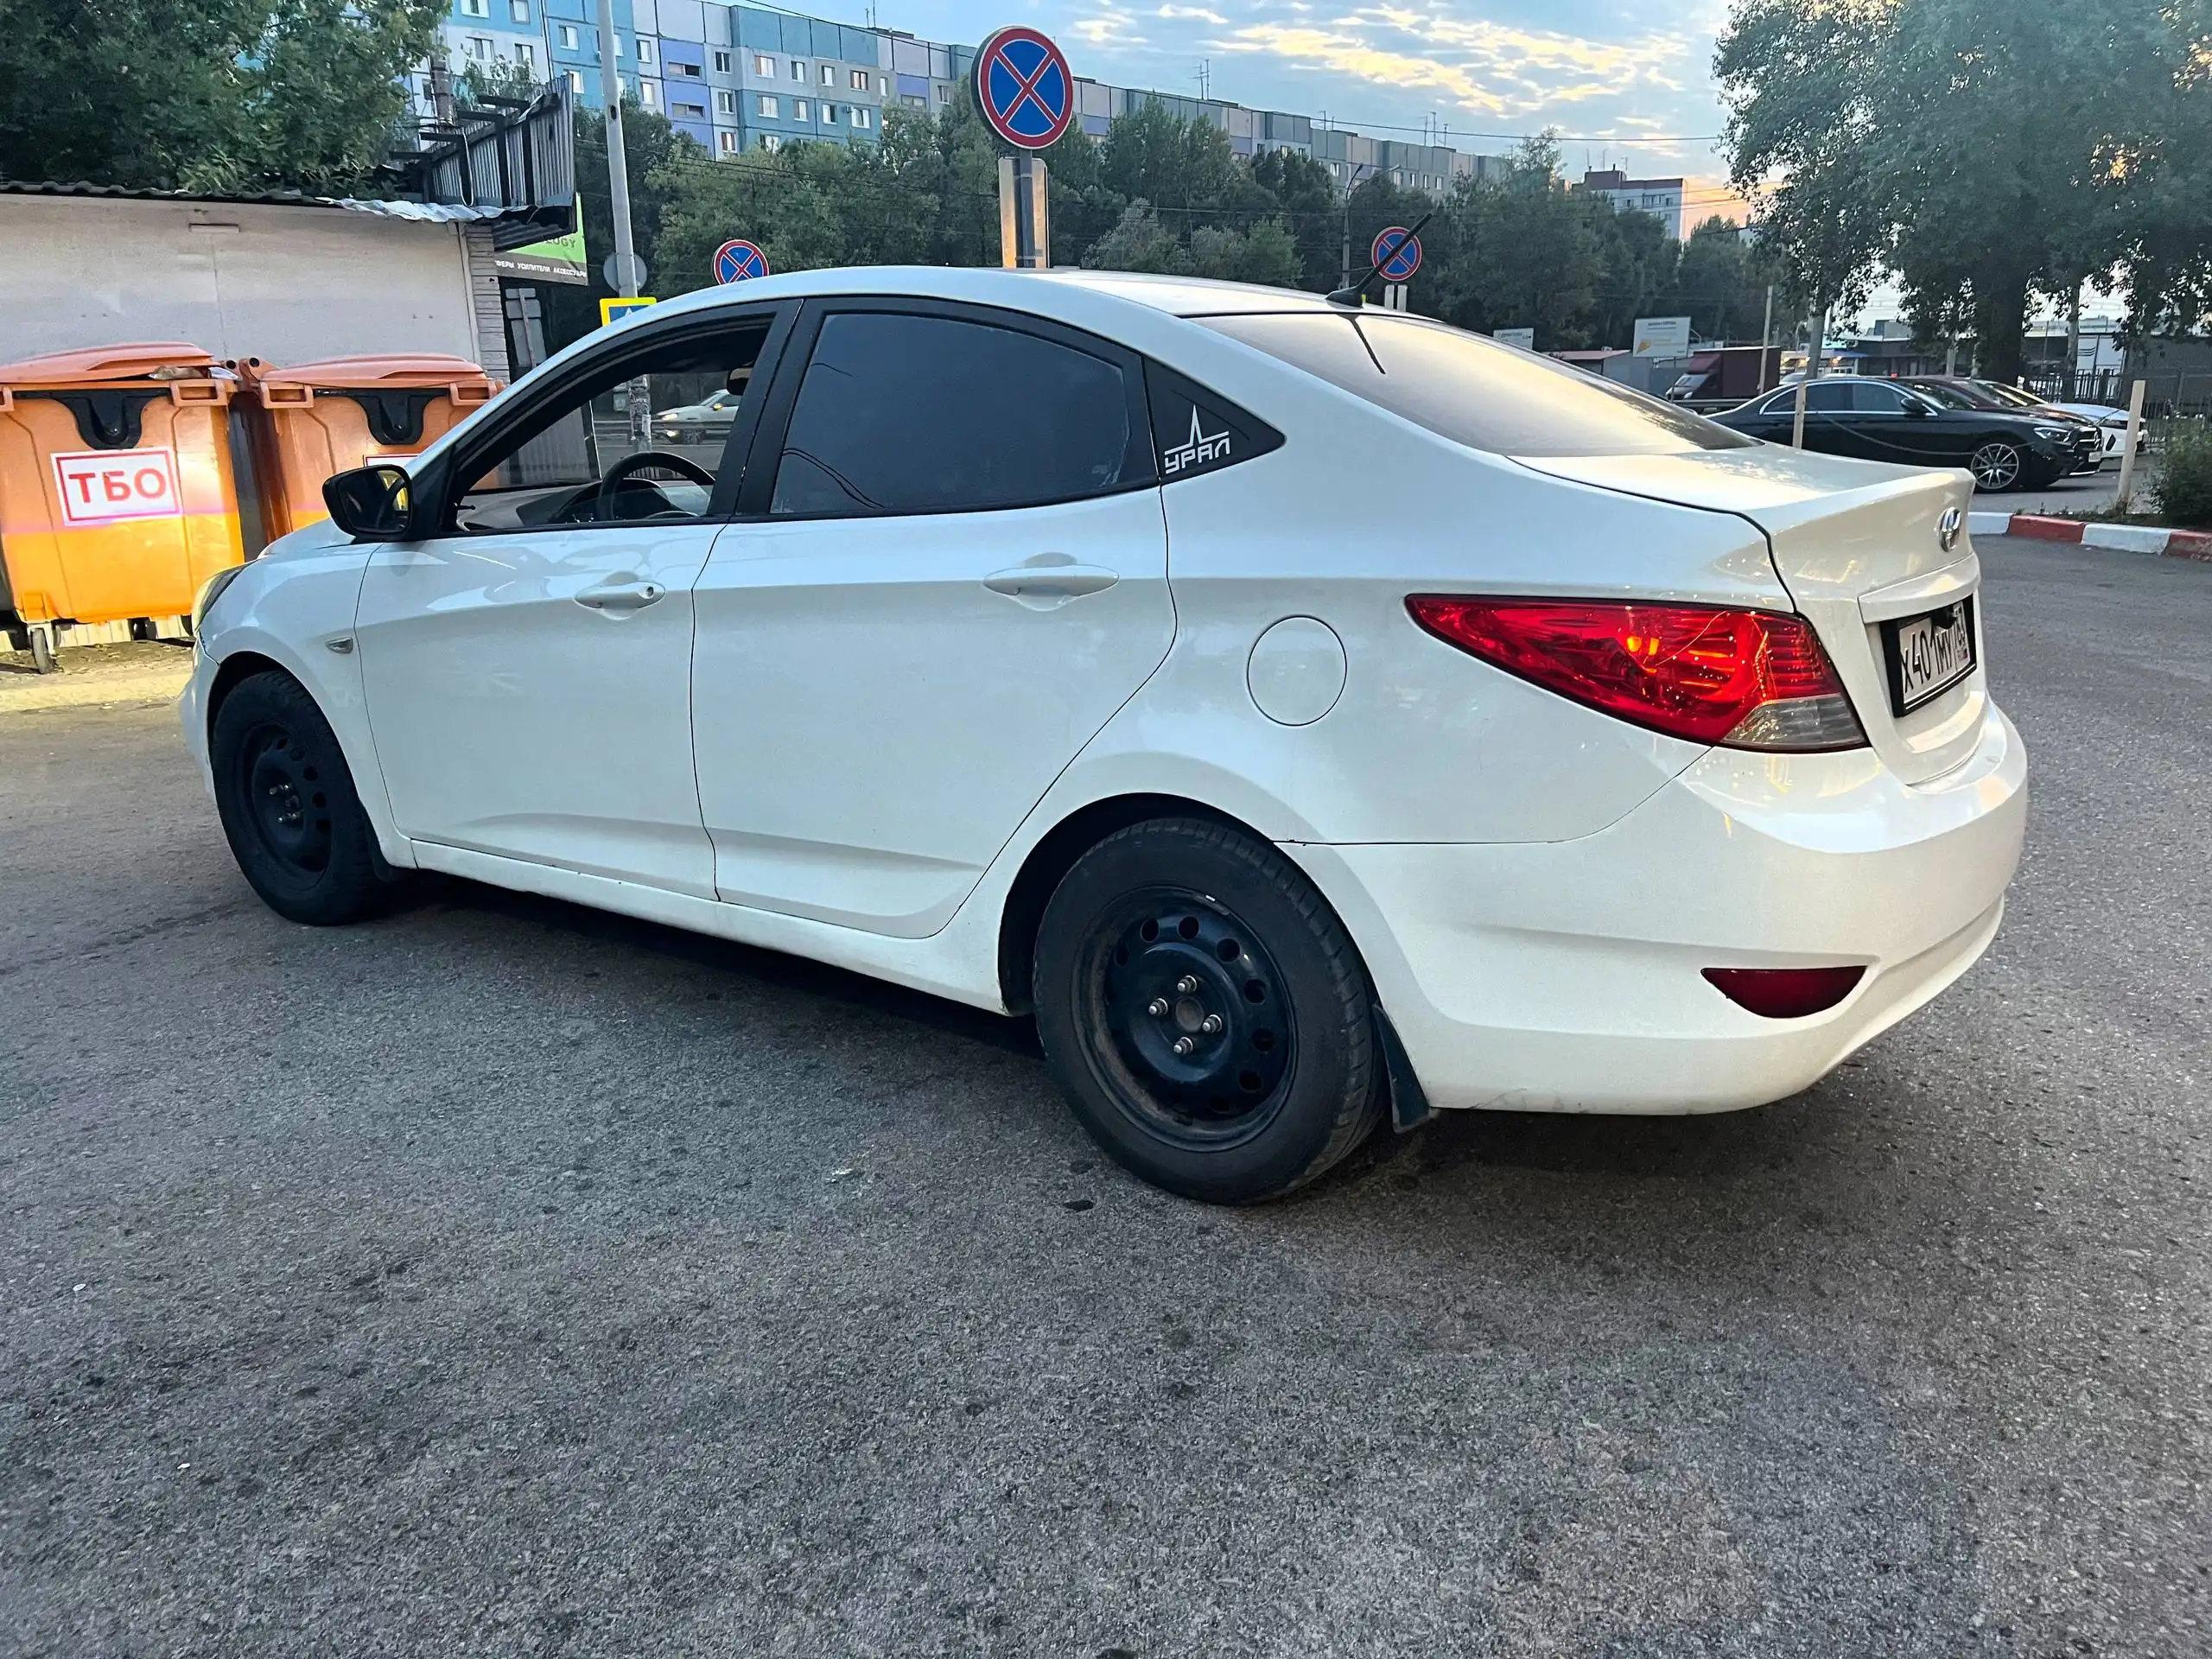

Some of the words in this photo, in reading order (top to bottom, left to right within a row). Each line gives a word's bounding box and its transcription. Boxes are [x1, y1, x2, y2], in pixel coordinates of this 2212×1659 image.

[517, 263, 550, 273] УСИЛИТЕЛИ
[1164, 437, 1230, 474] УРАЛ
[68, 467, 167, 504] ТБО
